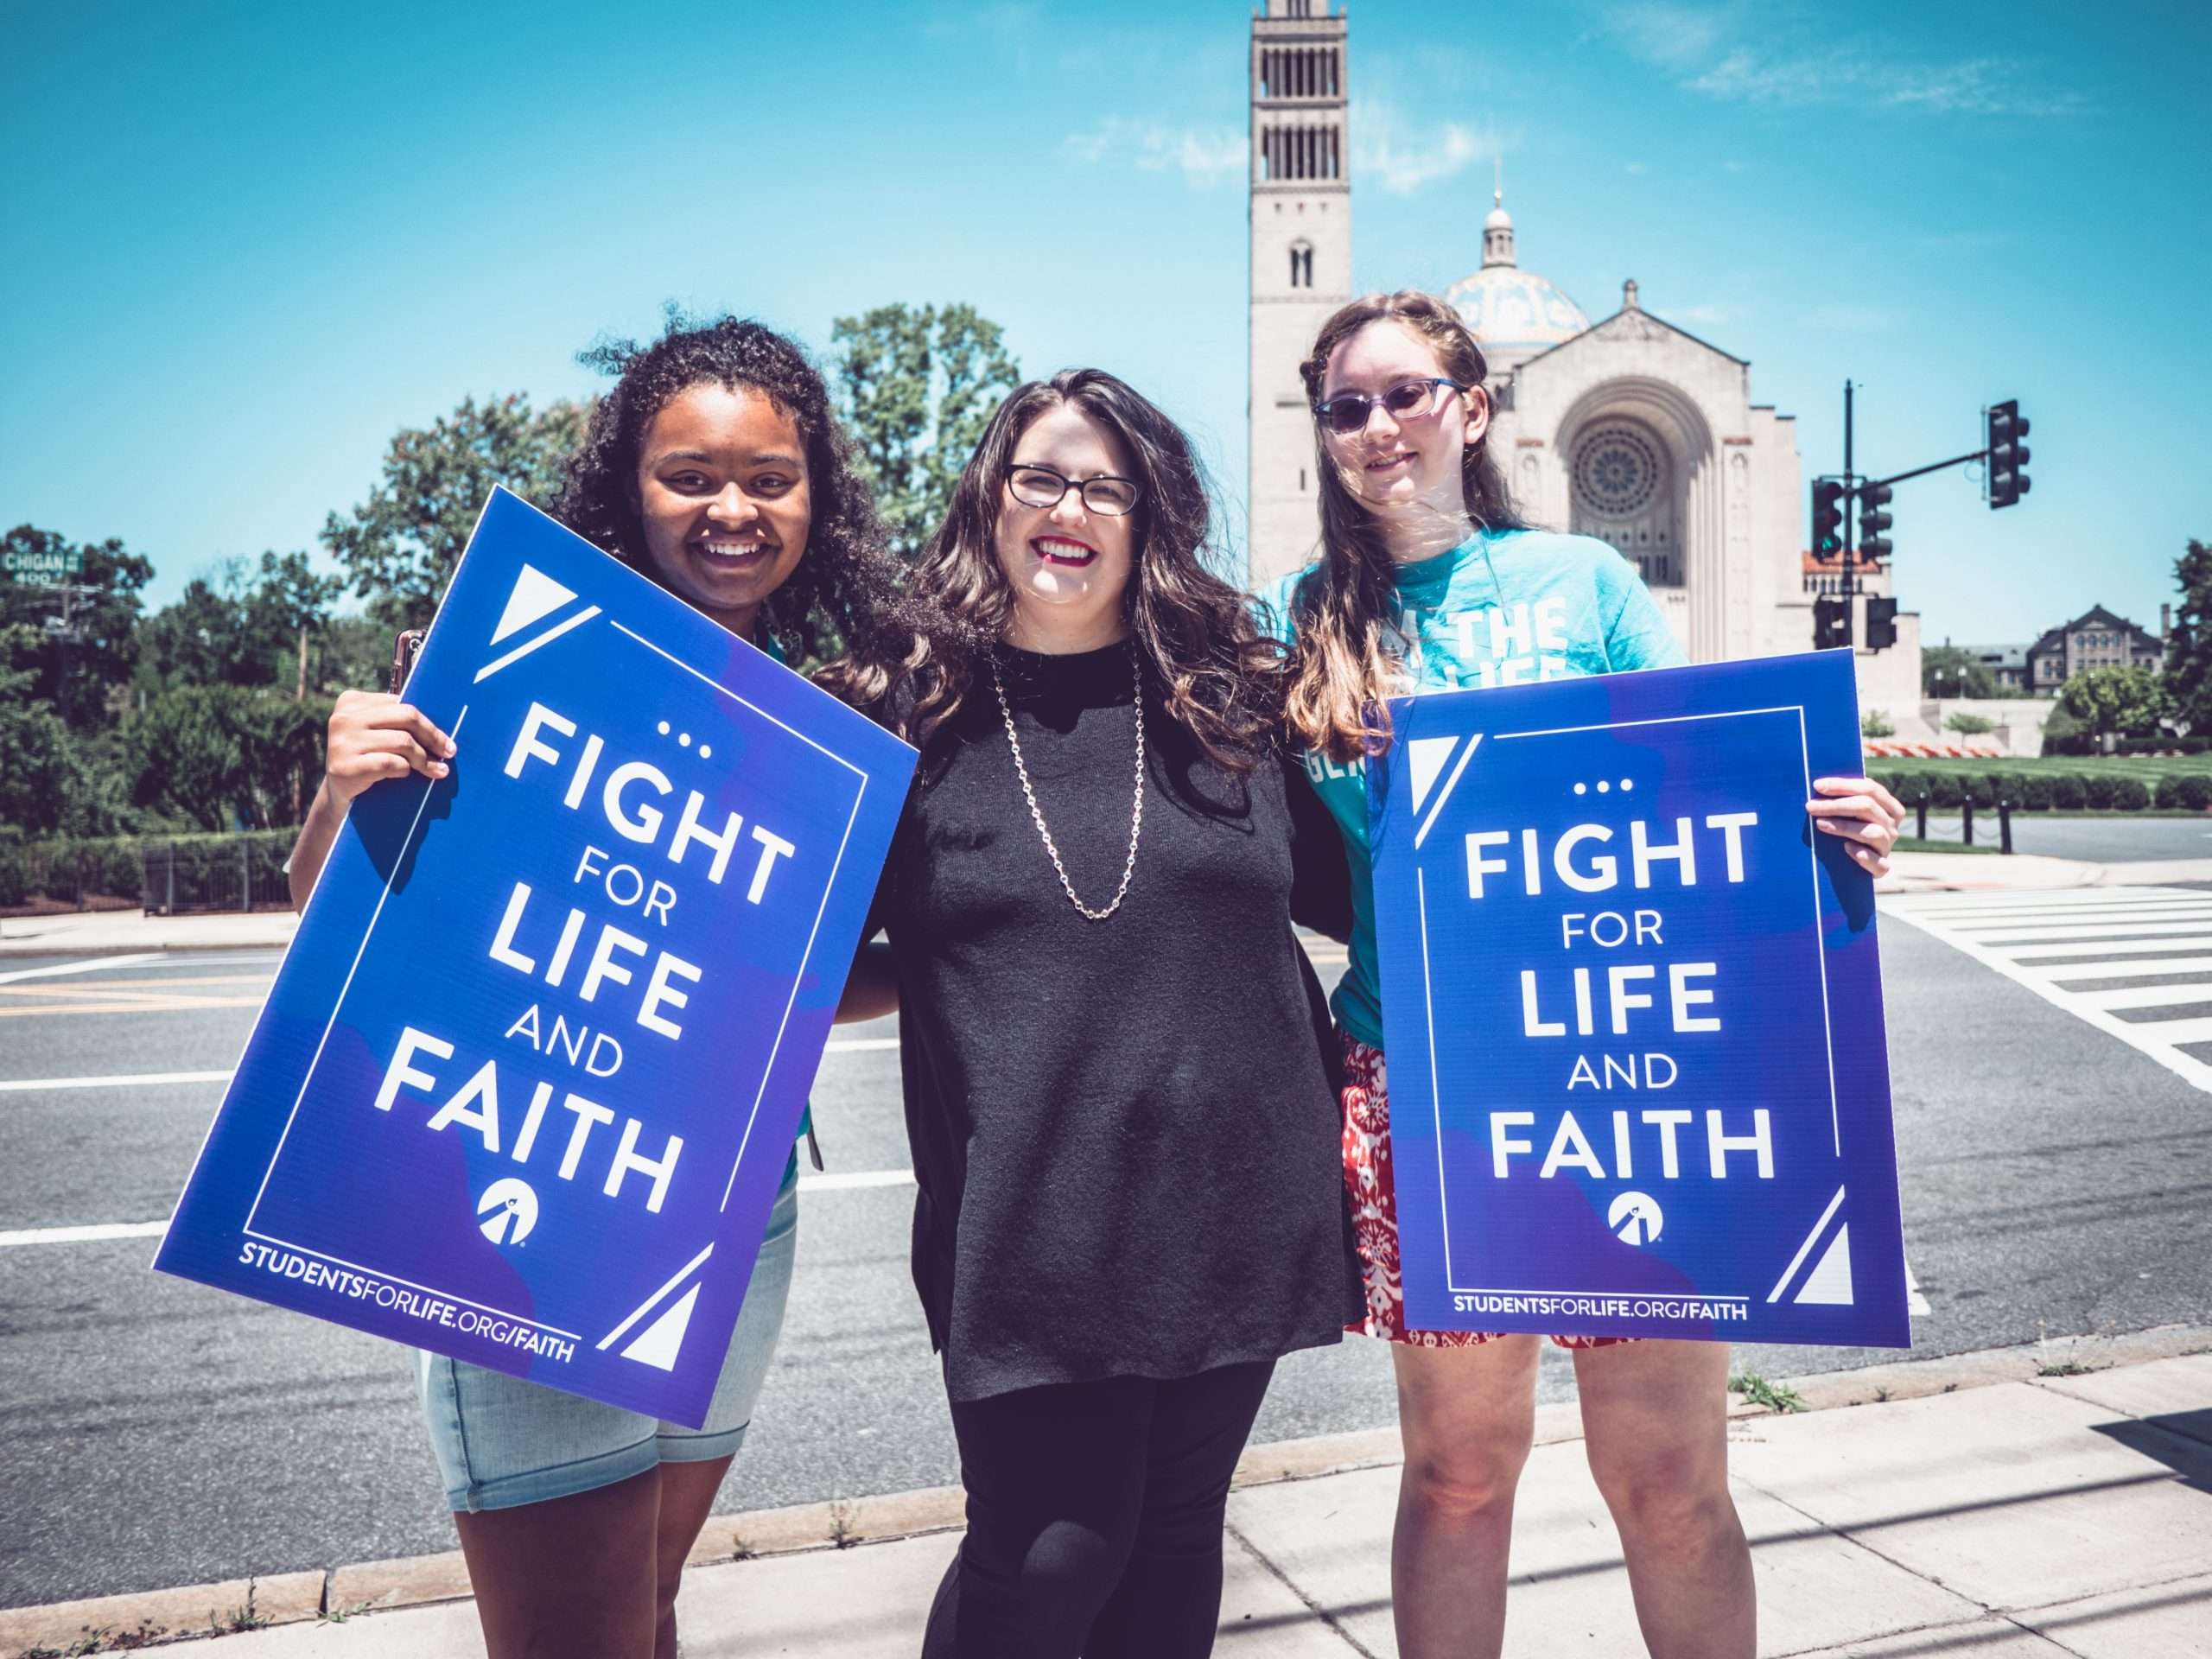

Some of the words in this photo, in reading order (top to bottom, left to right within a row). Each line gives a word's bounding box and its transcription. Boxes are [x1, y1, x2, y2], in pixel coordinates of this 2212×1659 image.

[1446, 596, 1568, 660] THE
[504, 702, 796, 906] FIGHT
[574, 845, 677, 927] FOR
[1465, 811, 1758, 899] FIGHT
[488, 881, 702, 1041] LIFE
[1561, 909, 1664, 949] FOR
[1520, 962, 1722, 1038] LIFE
[505, 1004, 623, 1077] AND
[1567, 1052, 1679, 1090] AND
[373, 1026, 684, 1215] FAITH
[1489, 1109, 1775, 1180] FAITH
[238, 1242, 576, 1363] STUDENTSFORLIFE.ORG/FAITH
[1452, 1294, 1748, 1321] STUDENTSFORLIFE.ORG/FAITH
